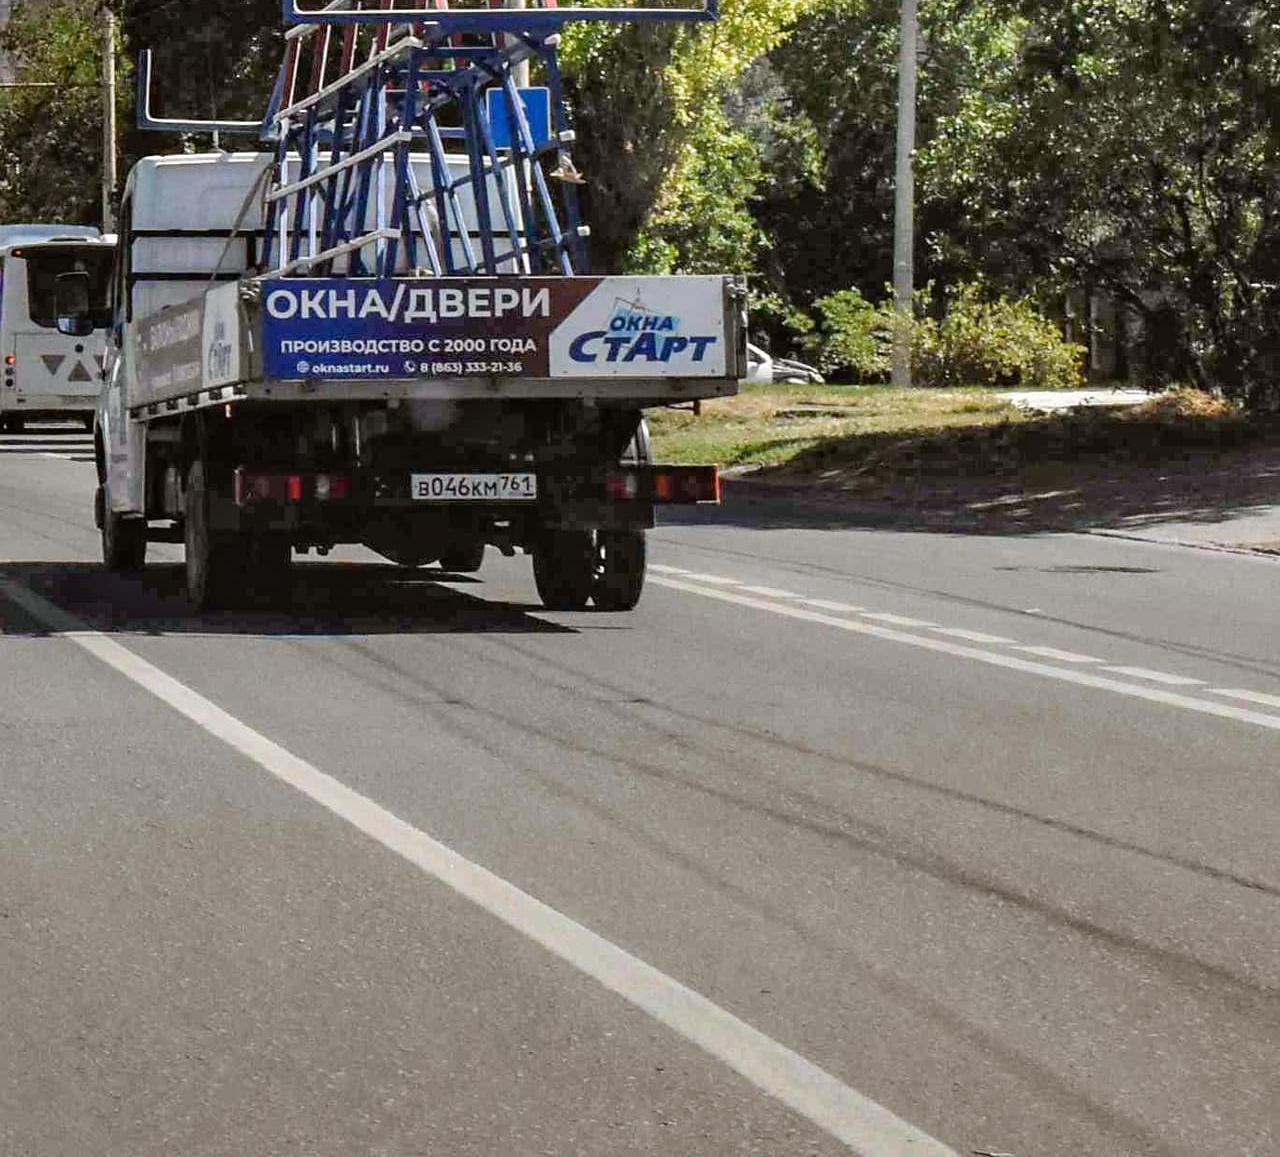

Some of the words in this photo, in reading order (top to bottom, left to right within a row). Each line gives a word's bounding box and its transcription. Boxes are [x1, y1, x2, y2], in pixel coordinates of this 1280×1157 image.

[266, 283, 551, 324] ОКНА/ДВЕРИ
[609, 316, 674, 332] ОКНА
[281, 339, 423, 354] ПРОИЗВОДСТВО
[428, 339, 440, 353] С
[444, 339, 486, 353] 2000
[489, 339, 537, 354] ГОДА
[312, 361, 390, 374] oknastart.ru
[420, 362, 429, 373] 8
[431, 360, 462, 374] (863)
[465, 361, 523, 373] 333-21-36
[501, 476, 531, 491] 761
